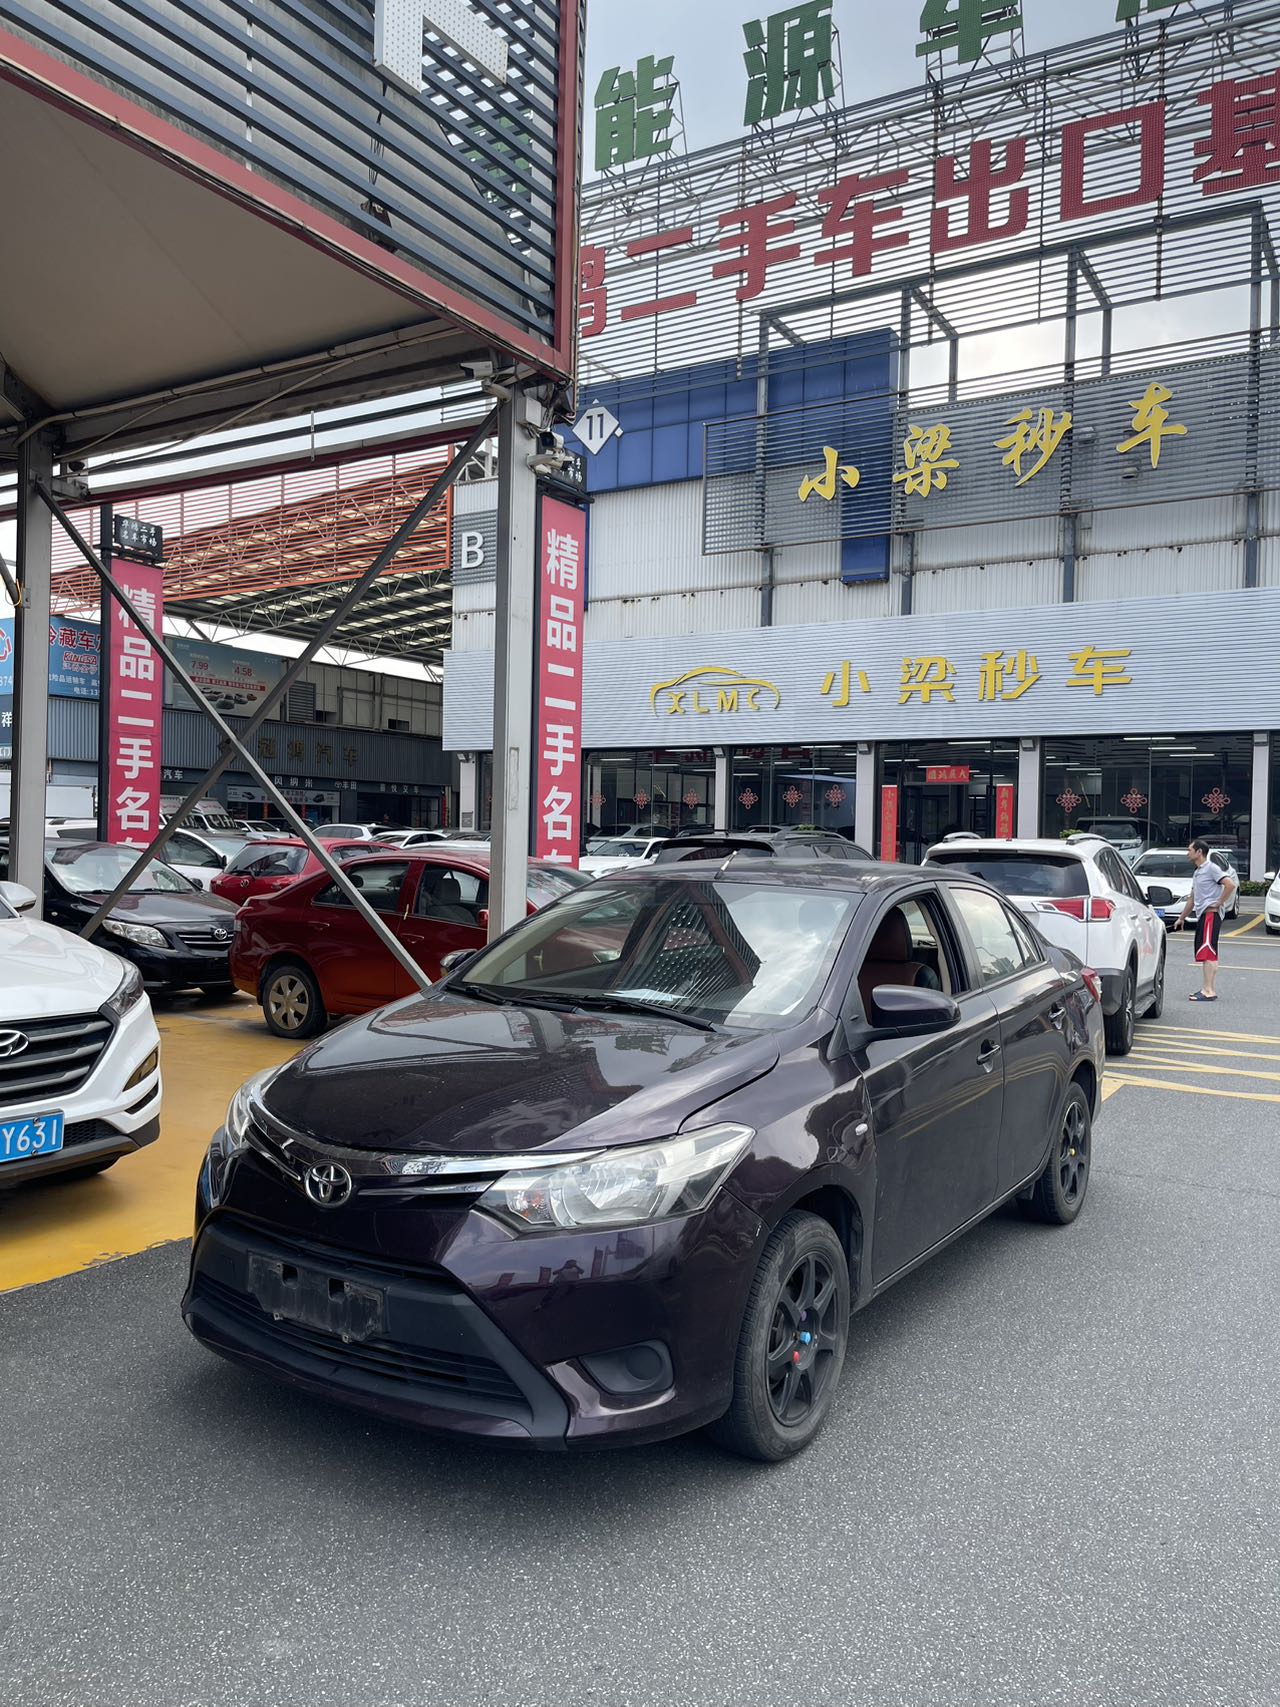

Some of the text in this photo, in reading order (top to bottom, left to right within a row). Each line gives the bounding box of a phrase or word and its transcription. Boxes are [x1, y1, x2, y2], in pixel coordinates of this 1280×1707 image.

[595, 0, 1193, 171] 能源车
[586, 413, 604, 441] 11
[797, 382, 1188, 502] 小梁秒车
[461, 531, 485, 569] B
[49, 673, 86, 685] 险品运输车
[820, 645, 1132, 707] 小梁秒车
[667, 687, 761, 715] XLMC
[2, 711, 13, 728] 祥
[160, 768, 184, 780] 汽车
[2, 1119, 57, 1155] Y631
